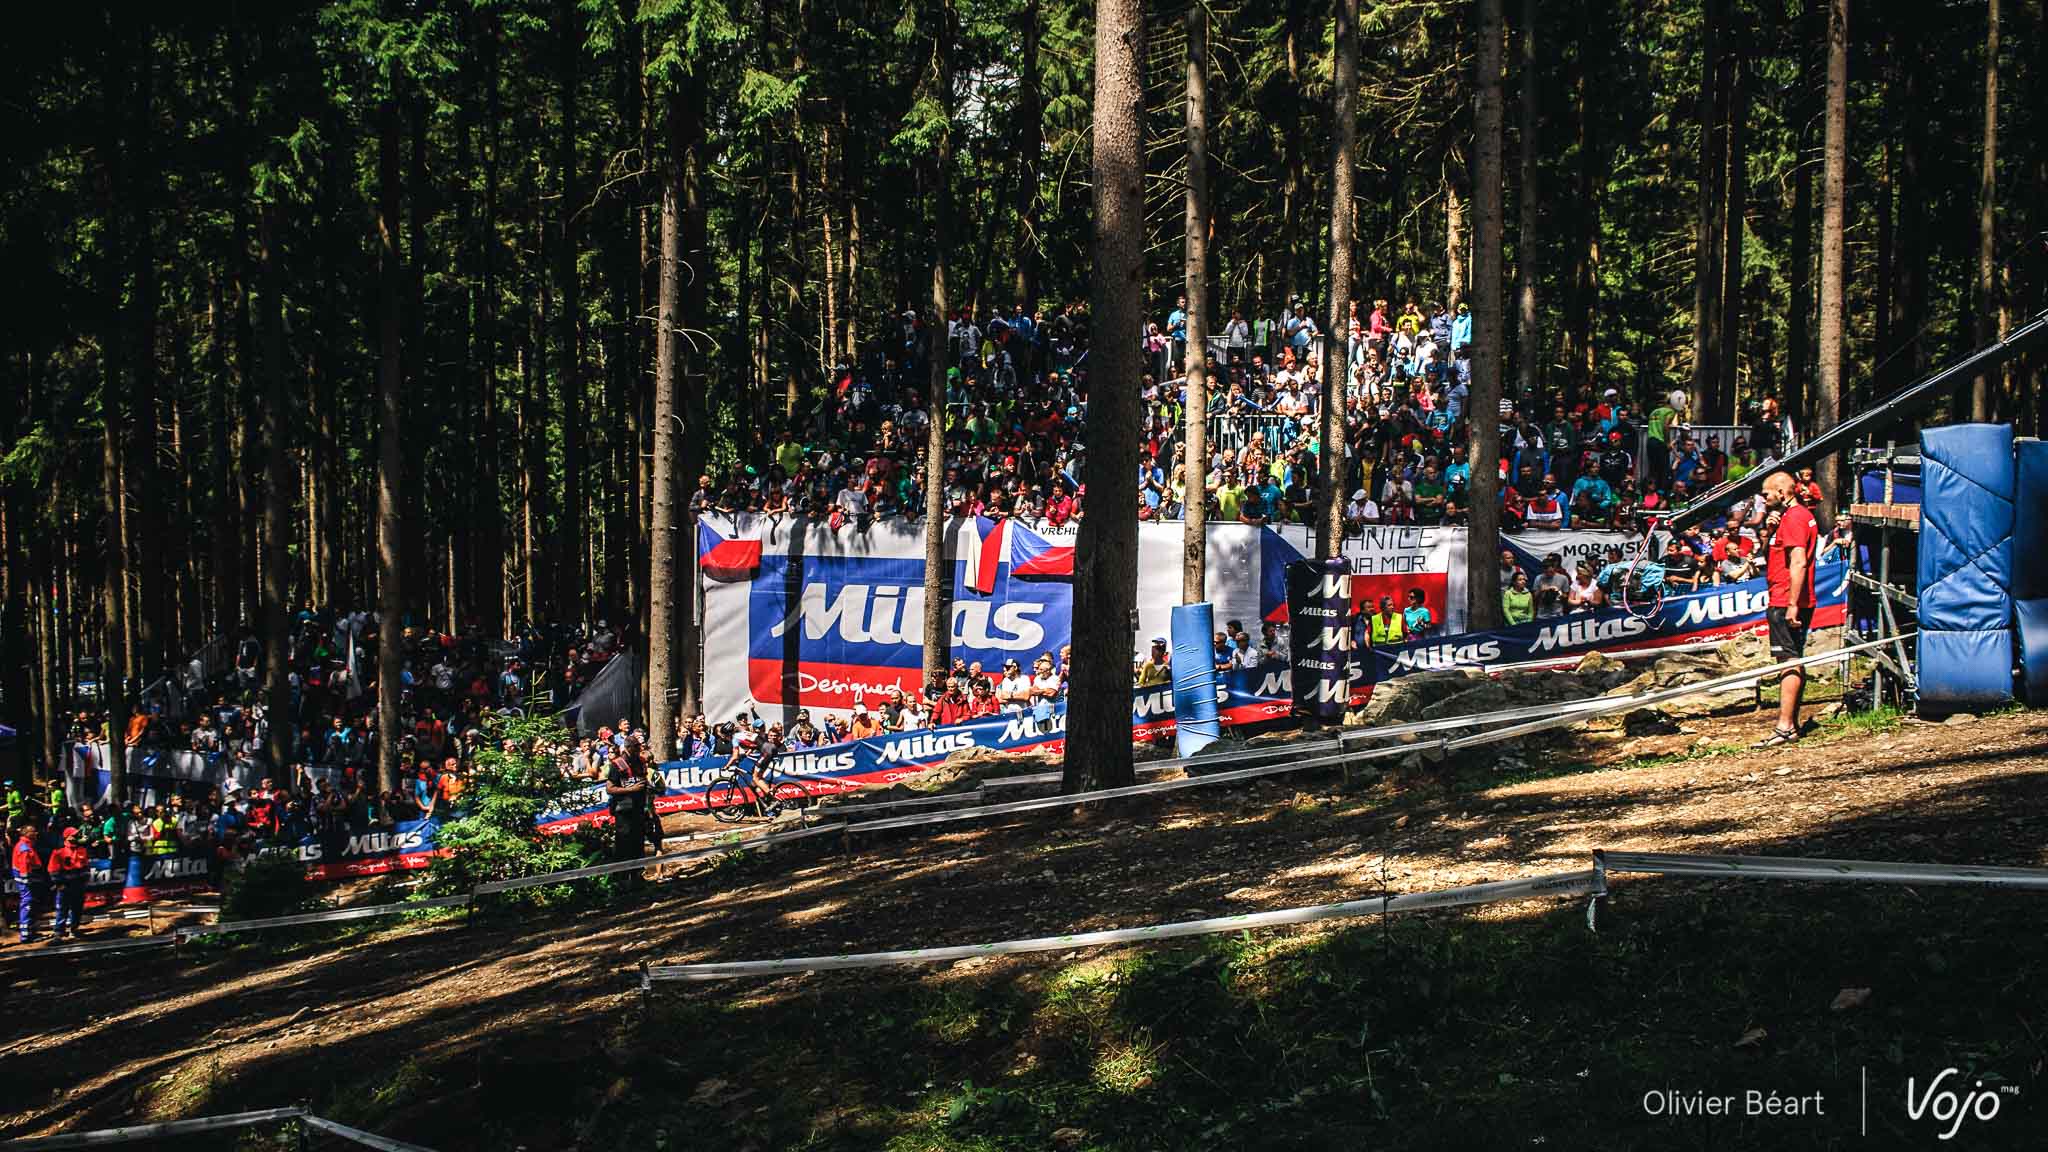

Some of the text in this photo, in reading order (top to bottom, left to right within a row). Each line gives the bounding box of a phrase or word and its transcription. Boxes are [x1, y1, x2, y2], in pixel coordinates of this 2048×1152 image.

[1299, 606, 1338, 617] Mitas
[1528, 615, 1647, 653] Mitas
[1298, 659, 1335, 670] Mitas
[1387, 640, 1501, 674] Mitas
[783, 672, 902, 702] Designed
[876, 731, 975, 765] Mitas
[762, 752, 856, 778] Mitas
[341, 831, 423, 857] Mitas
